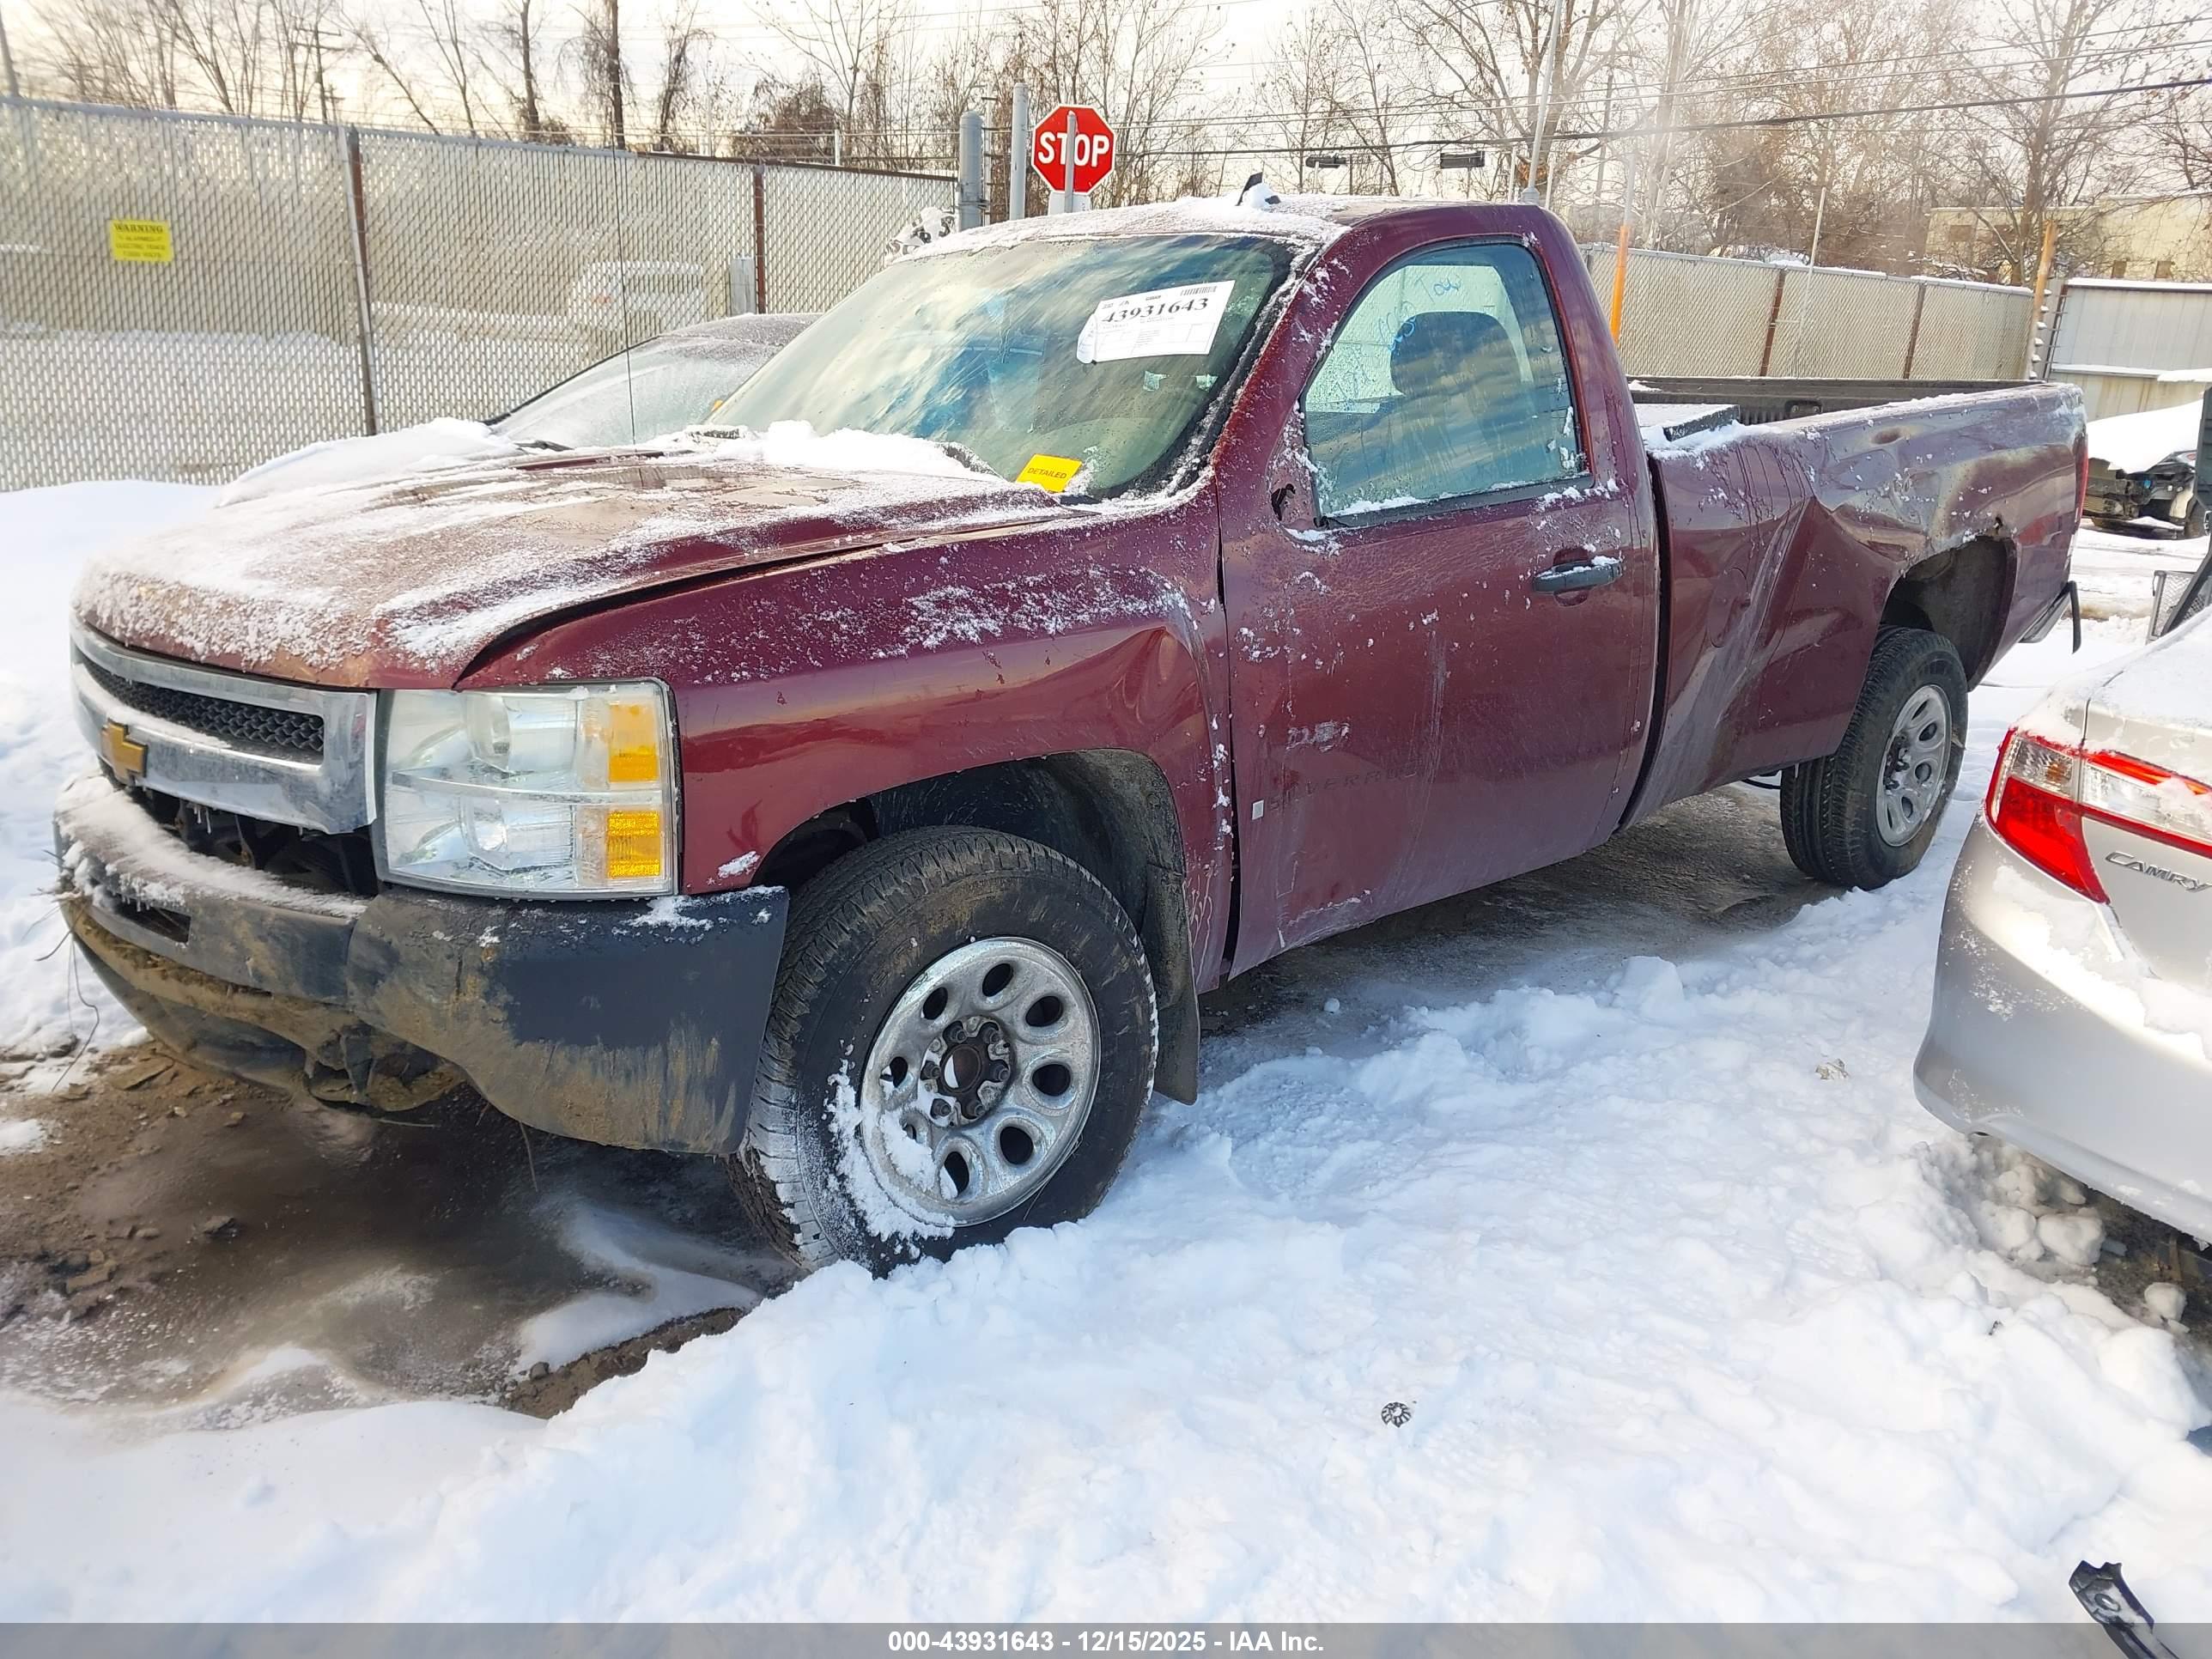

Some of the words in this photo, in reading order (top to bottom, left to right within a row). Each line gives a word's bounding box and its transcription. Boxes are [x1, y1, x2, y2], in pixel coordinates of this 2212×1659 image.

[1037, 131, 1109, 167] STOP
[114, 224, 163, 234] WARNING
[1102, 297, 1209, 323] 43931643
[1027, 467, 1067, 479] DETAILED
[2105, 850, 2212, 893] CAMRY
